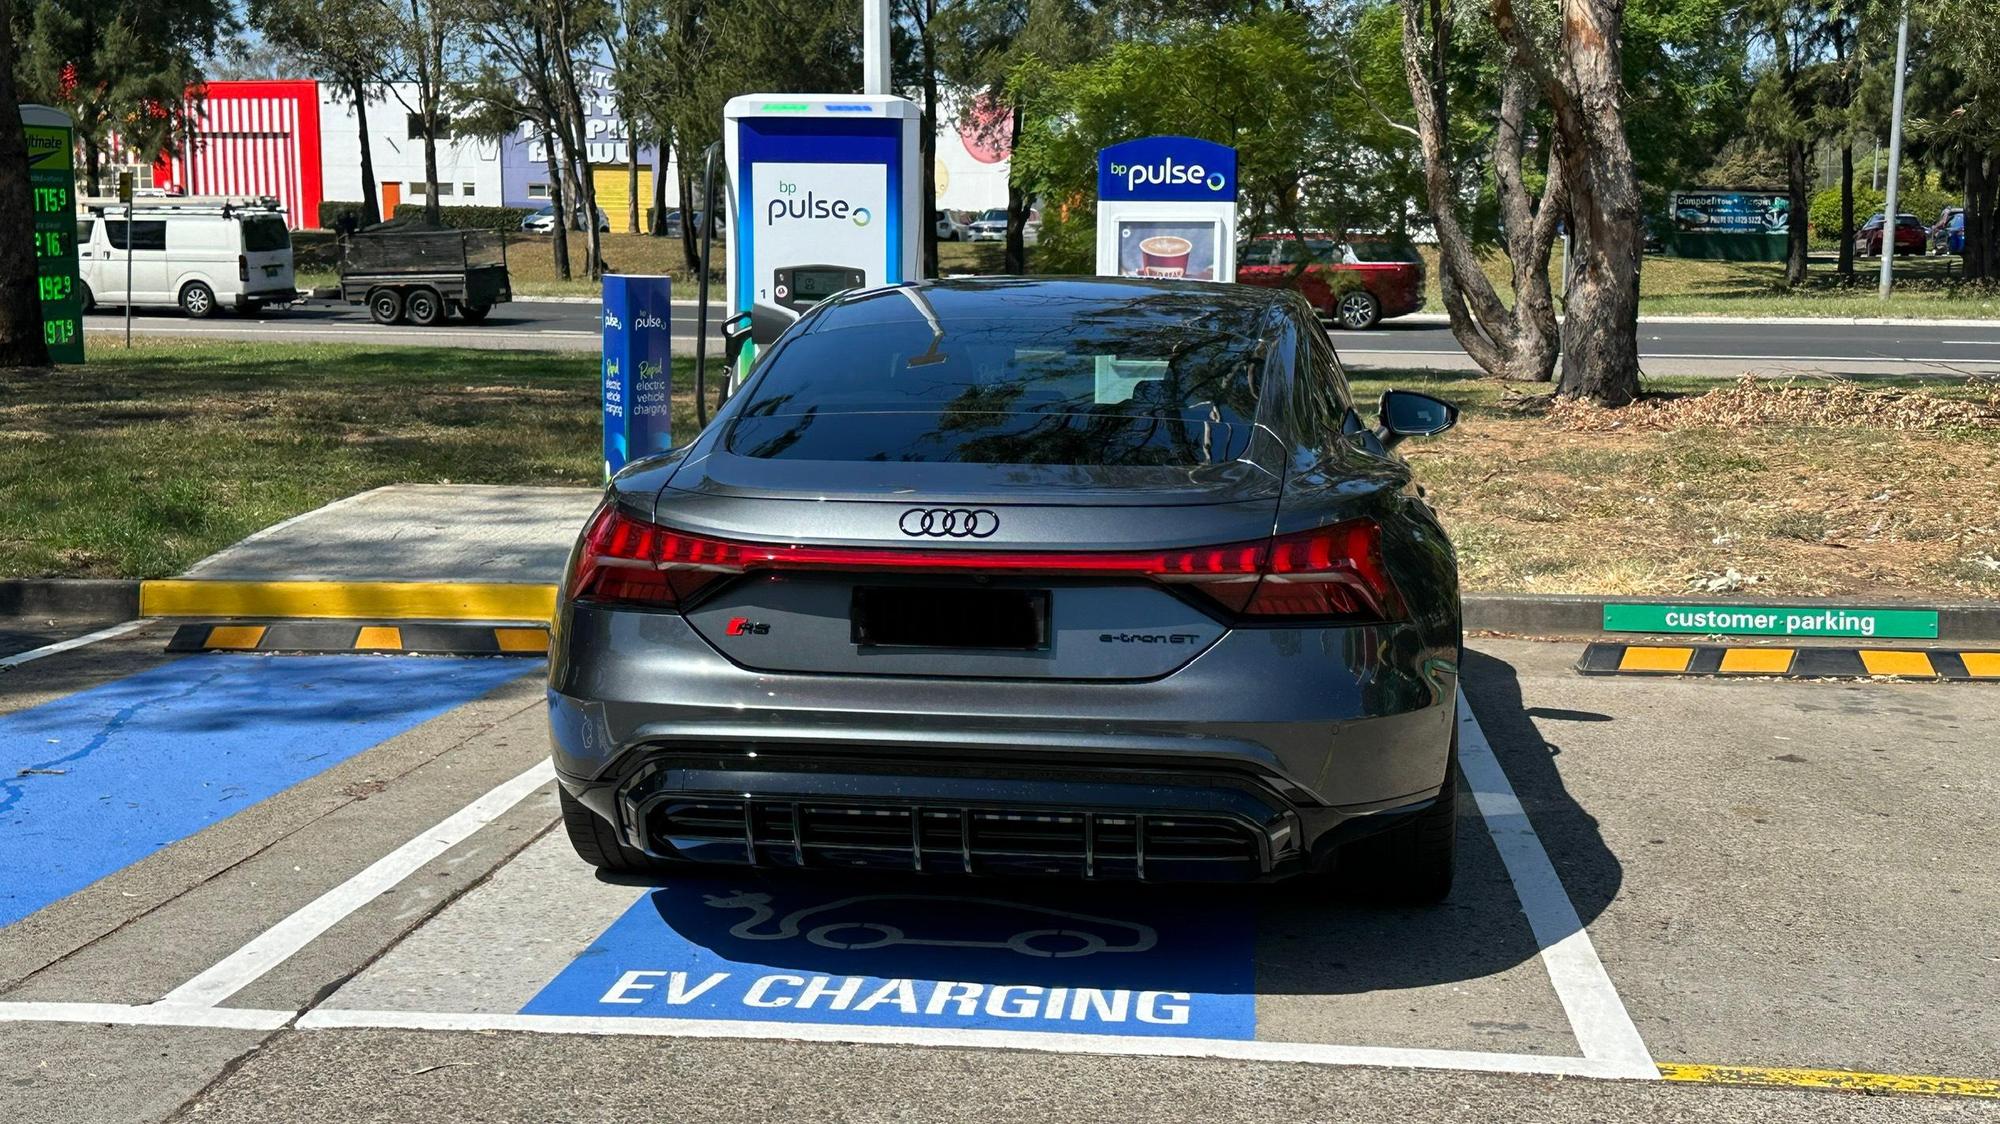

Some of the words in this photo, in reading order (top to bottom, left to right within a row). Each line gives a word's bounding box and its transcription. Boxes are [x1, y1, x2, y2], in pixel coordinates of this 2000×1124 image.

[1110, 162, 1127, 176] bp
[1128, 157, 1205, 191] pulse
[779, 181, 797, 195] bp
[768, 190, 849, 226] pulse
[760, 289, 766, 299] 1
[635, 314, 661, 331] pulse
[636, 380, 665, 391] electric
[637, 392, 665, 403] vehicle
[633, 404, 667, 416] charging
[1665, 610, 1777, 630] customer
[1786, 611, 1875, 635] parking
[600, 970, 730, 1006] EV
[742, 974, 1191, 1026] CHARGING
